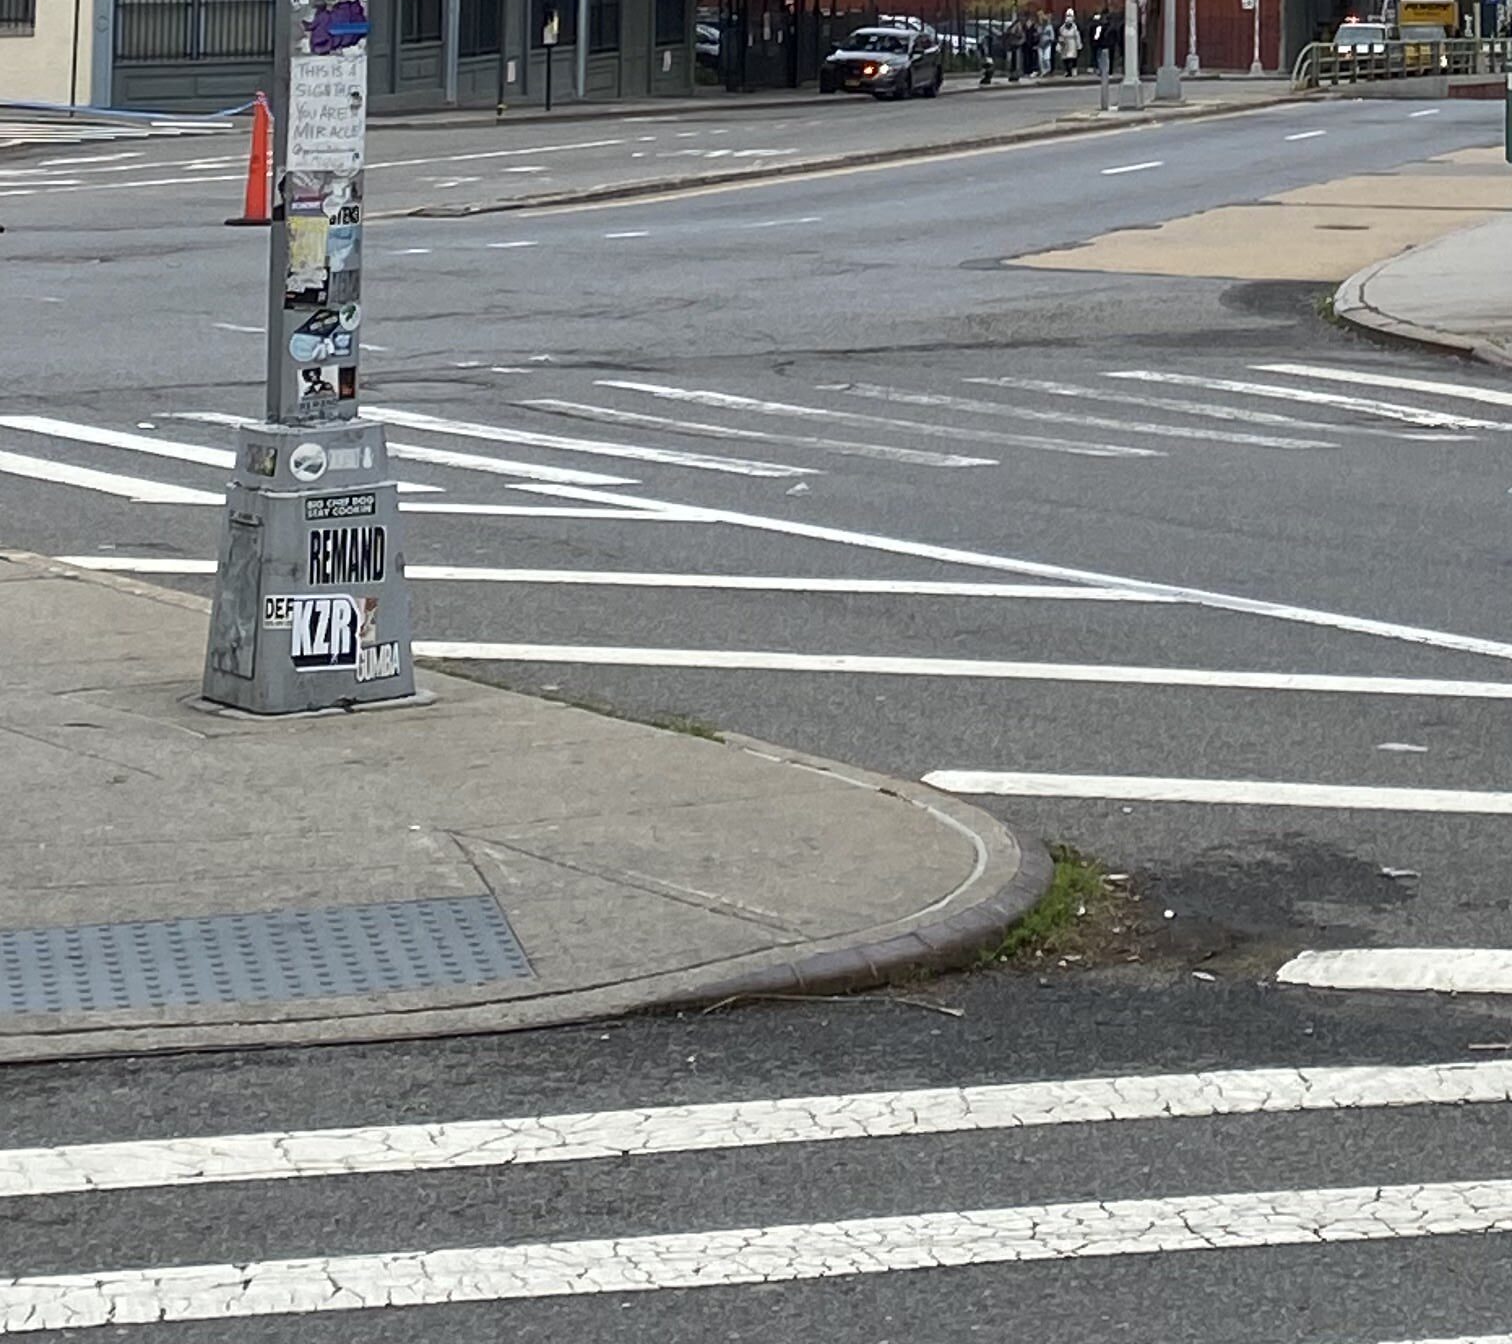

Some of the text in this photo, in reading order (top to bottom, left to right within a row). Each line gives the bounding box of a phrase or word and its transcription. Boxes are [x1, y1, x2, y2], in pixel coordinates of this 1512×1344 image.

[299, 63, 357, 78] THIS IS A
[295, 83, 330, 98] SIGN
[319, 105, 348, 121] ARE
[309, 525, 386, 586] REMAND
[291, 598, 353, 657] KZR
[356, 641, 400, 683] GUMBA
